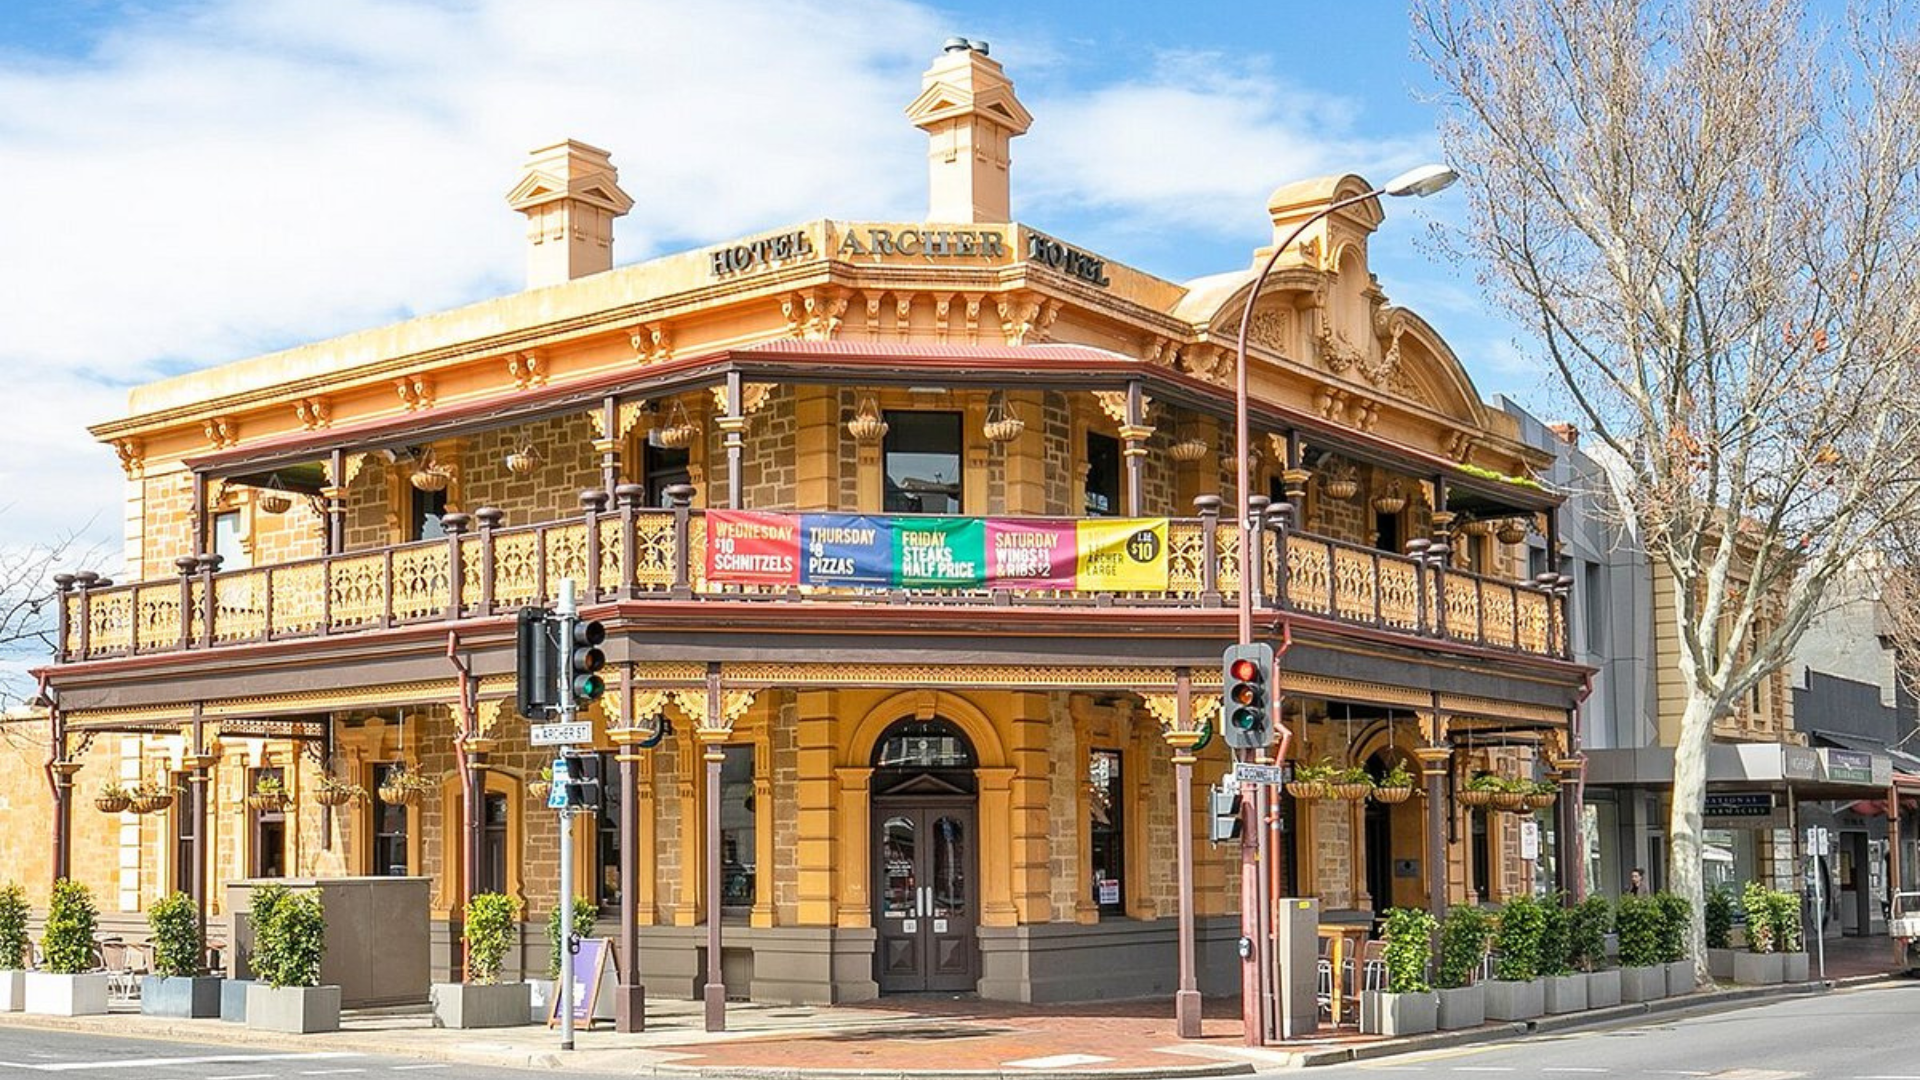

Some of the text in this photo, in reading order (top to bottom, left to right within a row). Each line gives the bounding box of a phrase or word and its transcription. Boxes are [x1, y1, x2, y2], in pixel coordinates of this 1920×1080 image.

[838, 229, 1004, 258] ARCHER
[709, 230, 813, 277] HOTEL
[1028, 232, 1110, 287] HOTEL
[715, 522, 793, 541] WEDNESDAY
[809, 527, 876, 546] THURSDAY
[902, 531, 947, 547] FRIDAY
[995, 532, 1058, 549] SATURDAY
[715, 538, 734, 554] $10
[809, 542, 824, 558] $8
[902, 546, 953, 563] STEAKS
[1131, 543, 1153, 561] $10
[714, 554, 793, 573] SCHNITZELS
[995, 547, 1037, 564] WINGS
[809, 557, 855, 576] PIZZAS
[902, 561, 976, 578] HALF PRICE
